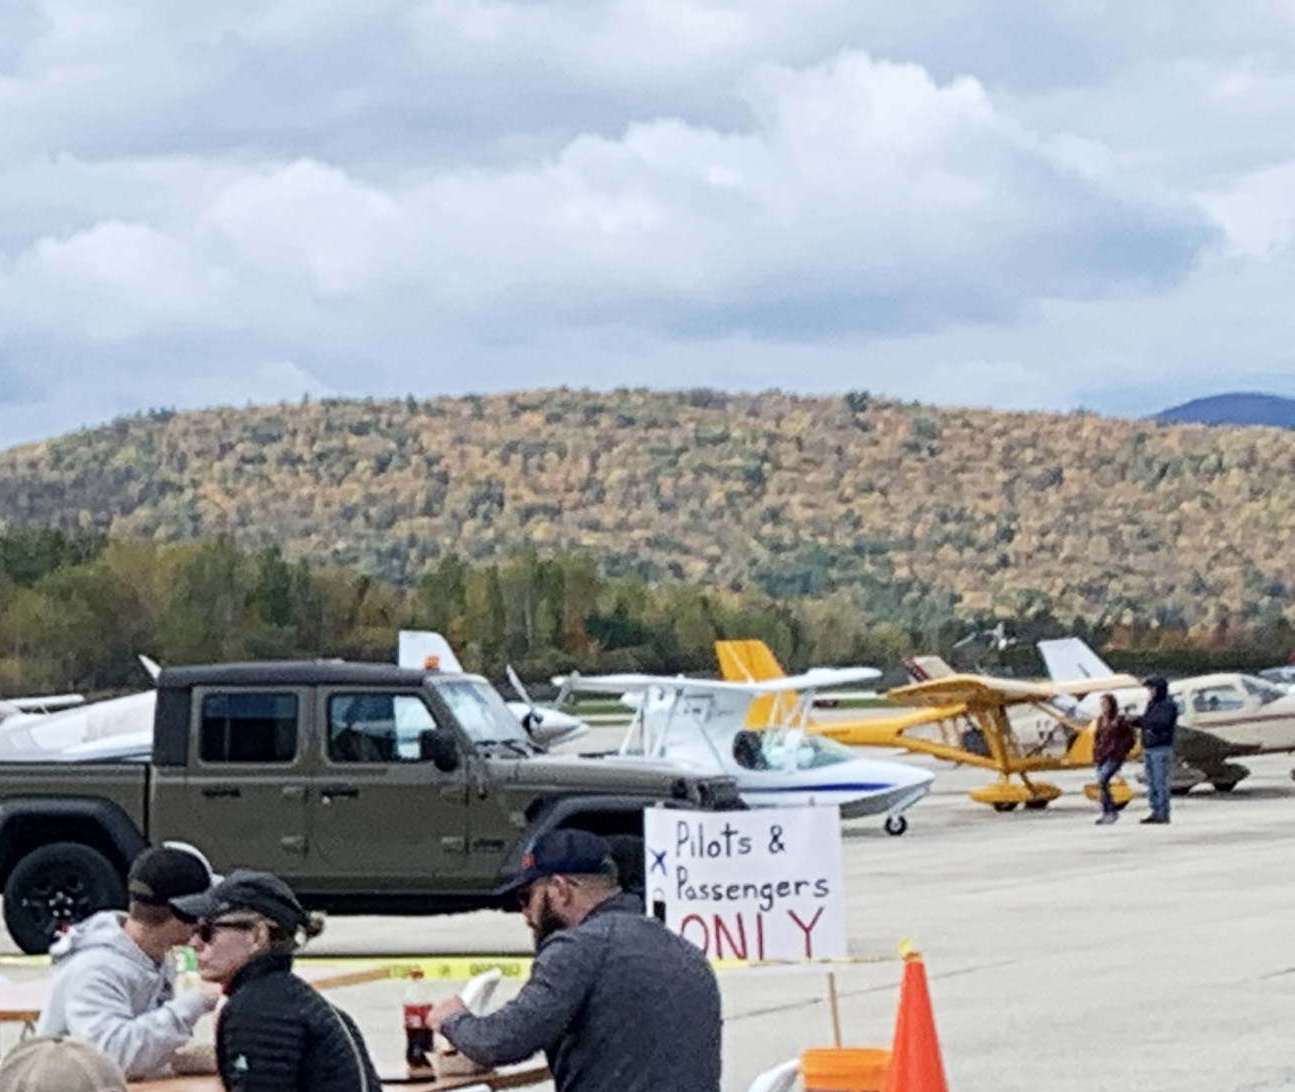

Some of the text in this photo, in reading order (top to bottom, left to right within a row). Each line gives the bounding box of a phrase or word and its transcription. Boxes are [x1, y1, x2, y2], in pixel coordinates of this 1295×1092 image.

[676, 820, 785, 857] Pilots &
[675, 865, 830, 911] Passengers
